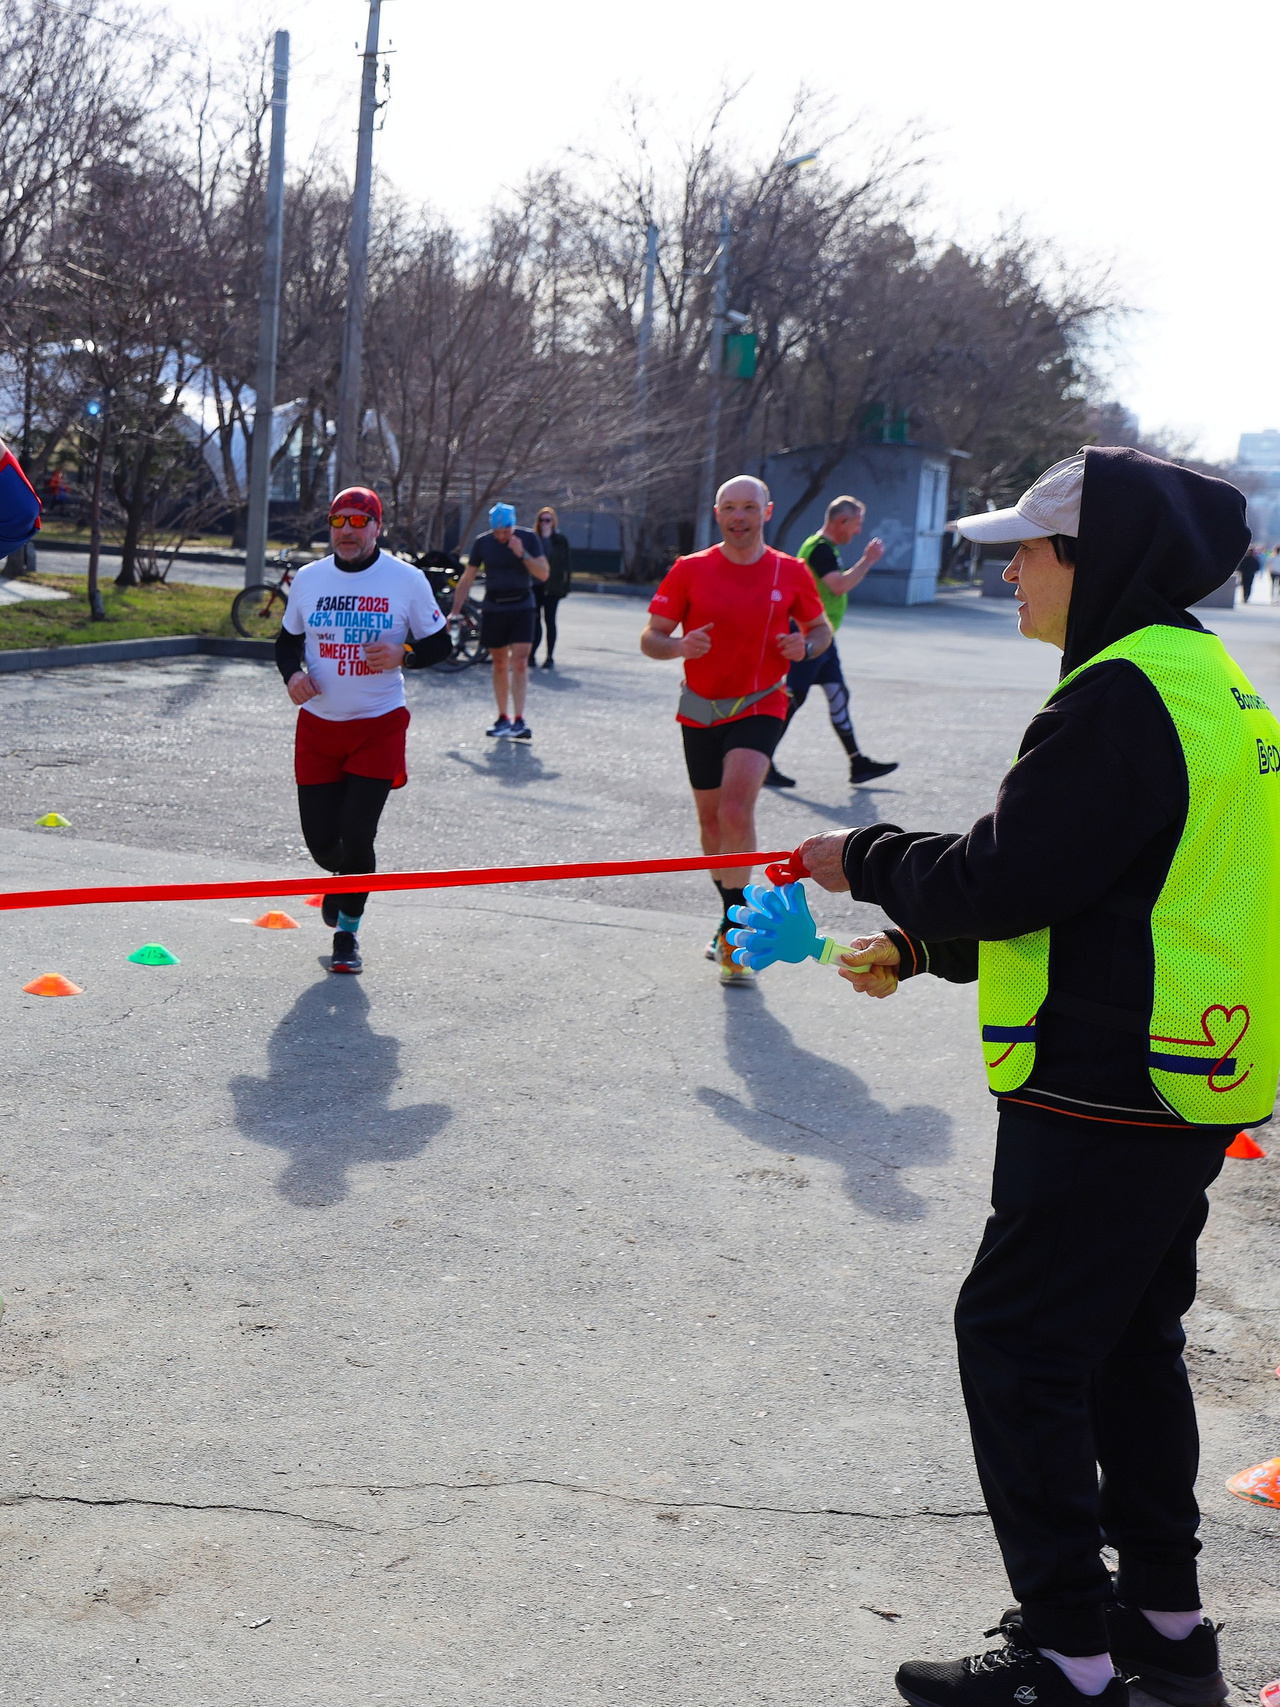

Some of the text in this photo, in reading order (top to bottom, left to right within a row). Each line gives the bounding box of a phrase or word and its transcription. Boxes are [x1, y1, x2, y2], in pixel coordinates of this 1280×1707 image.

[316, 596, 389, 613] #ЗАБЕГ2025
[308, 612, 393, 629] 45% ПЛАНЕТЫ
[344, 629, 381, 644] БЕГУТ
[319, 643, 360, 660] ВМЕСТЕ
[337, 660, 383, 676] С ТОБ
